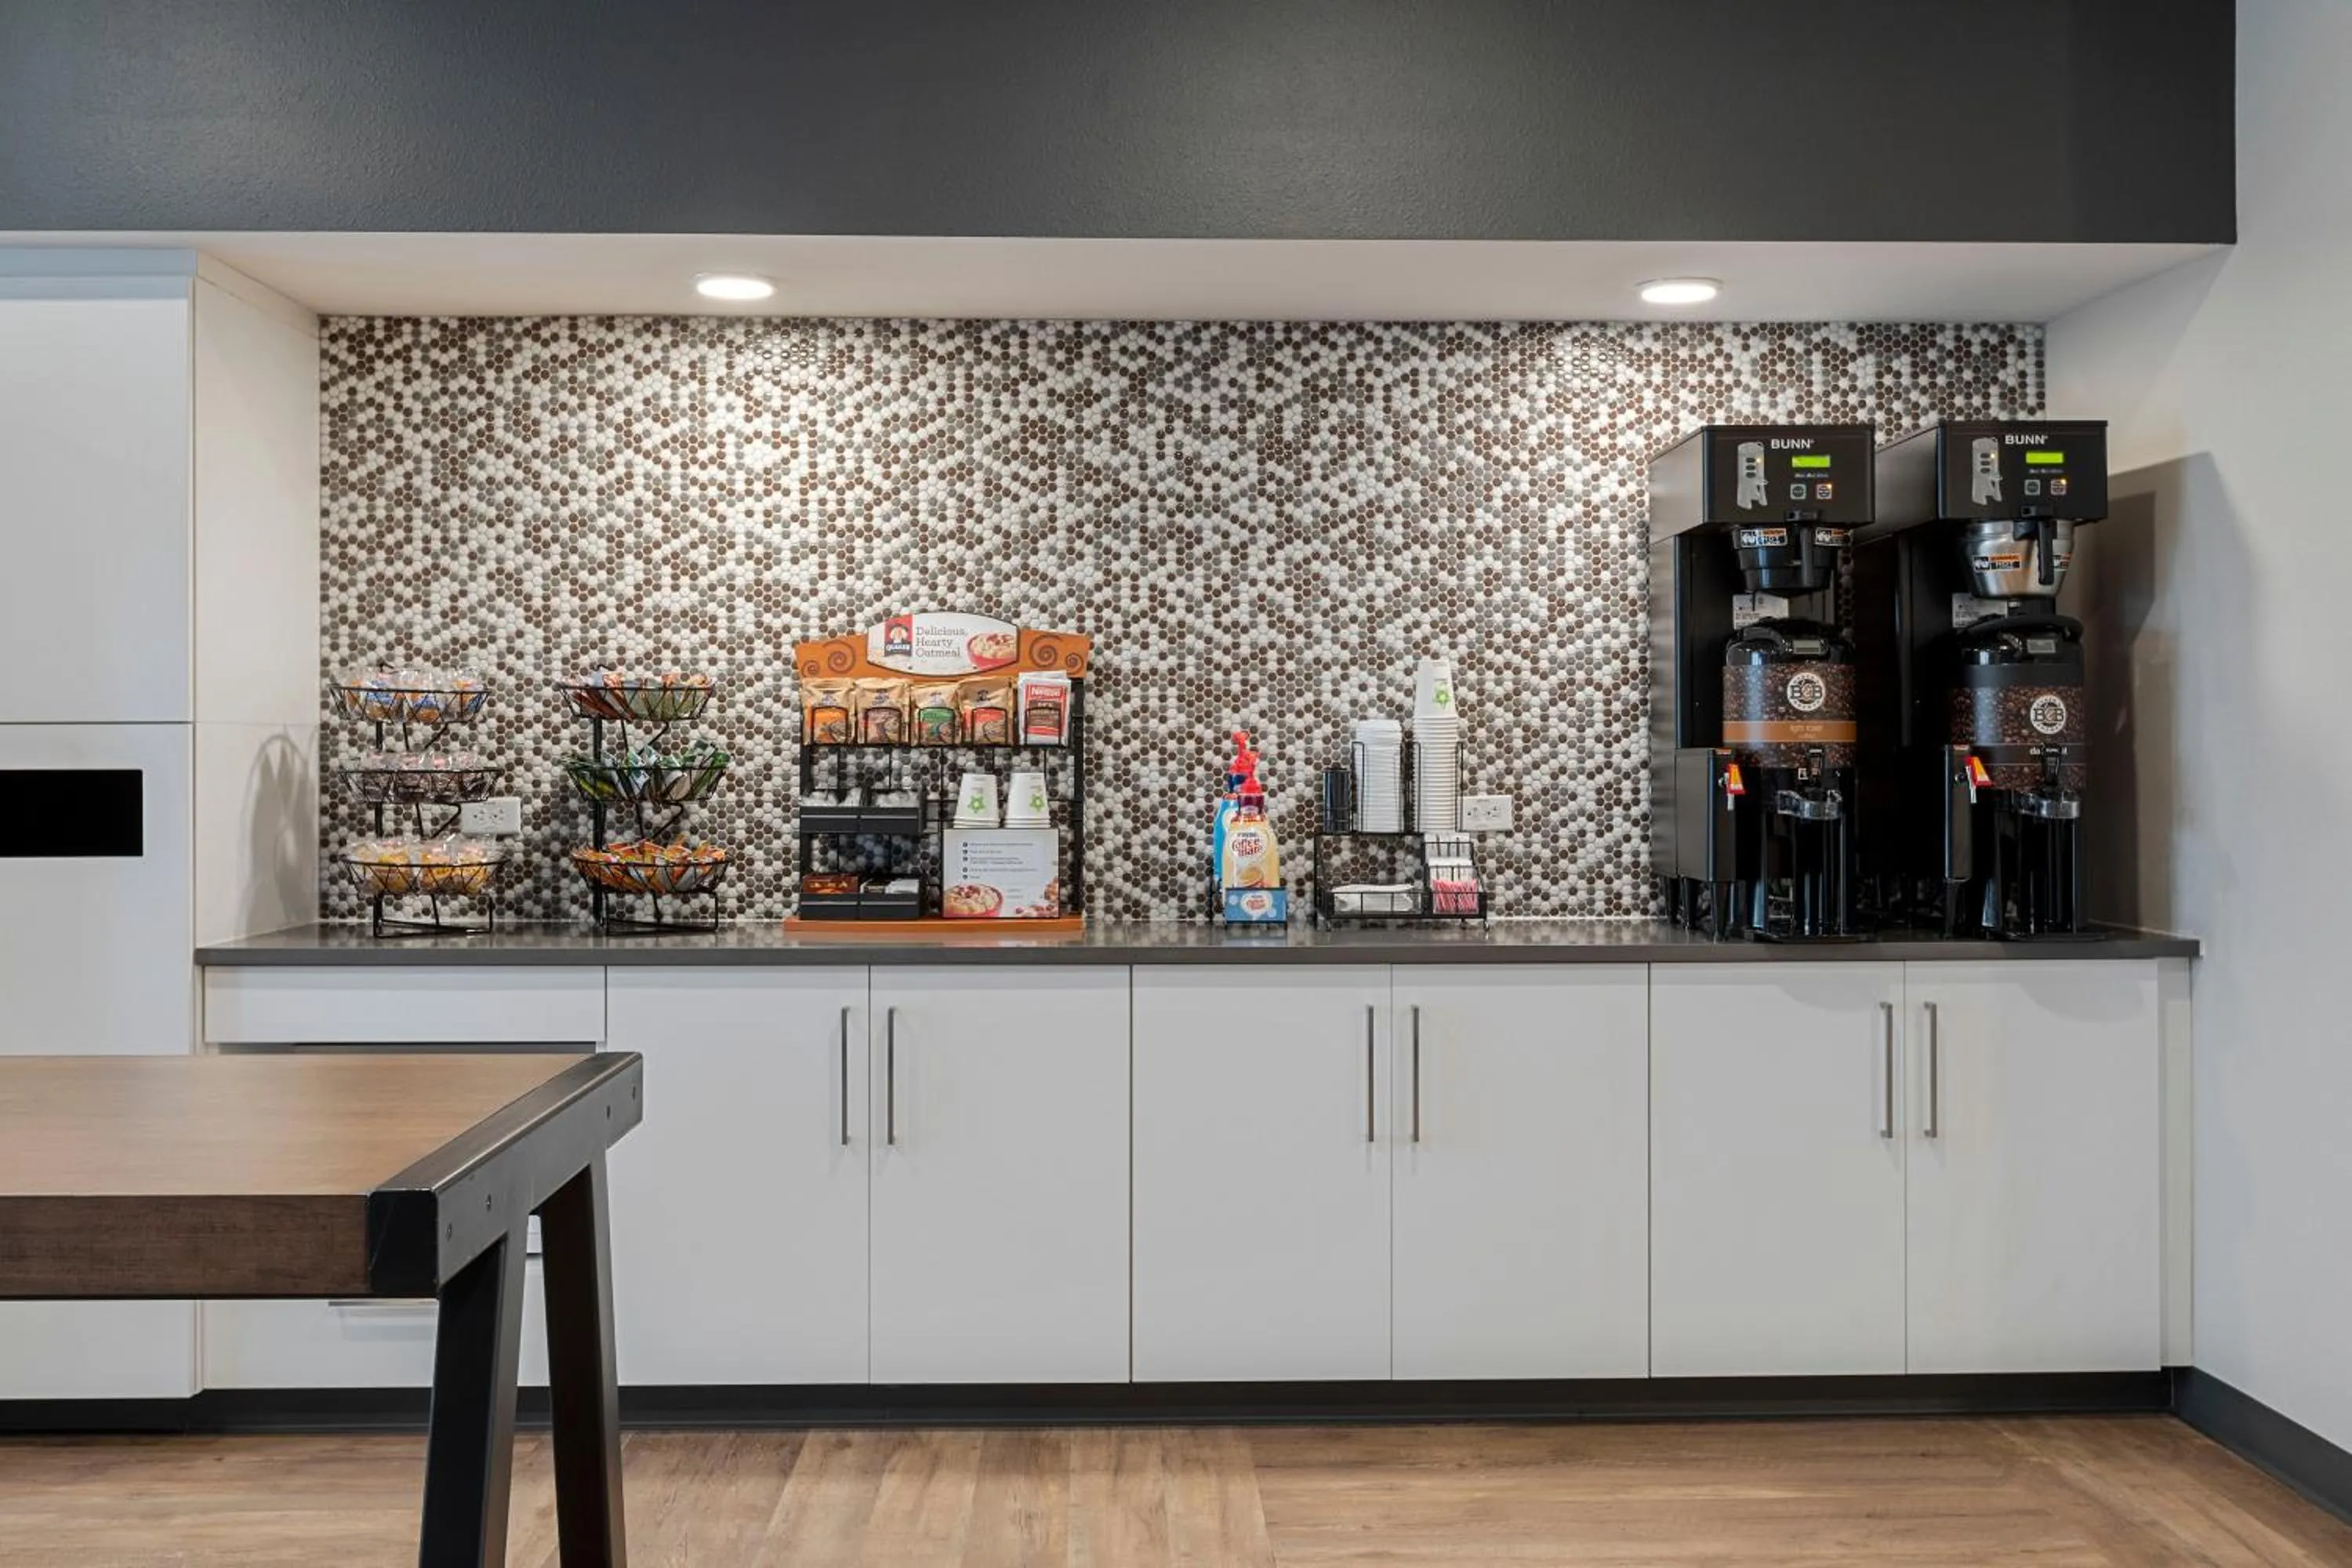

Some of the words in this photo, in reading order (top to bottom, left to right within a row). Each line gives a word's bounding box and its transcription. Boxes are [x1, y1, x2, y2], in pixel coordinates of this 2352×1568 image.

[1771, 438, 1811, 449] BUNN
[2005, 434, 2045, 445] BUNN
[916, 637, 953, 648] Hearty
[915, 647, 960, 658] Oatmeal
